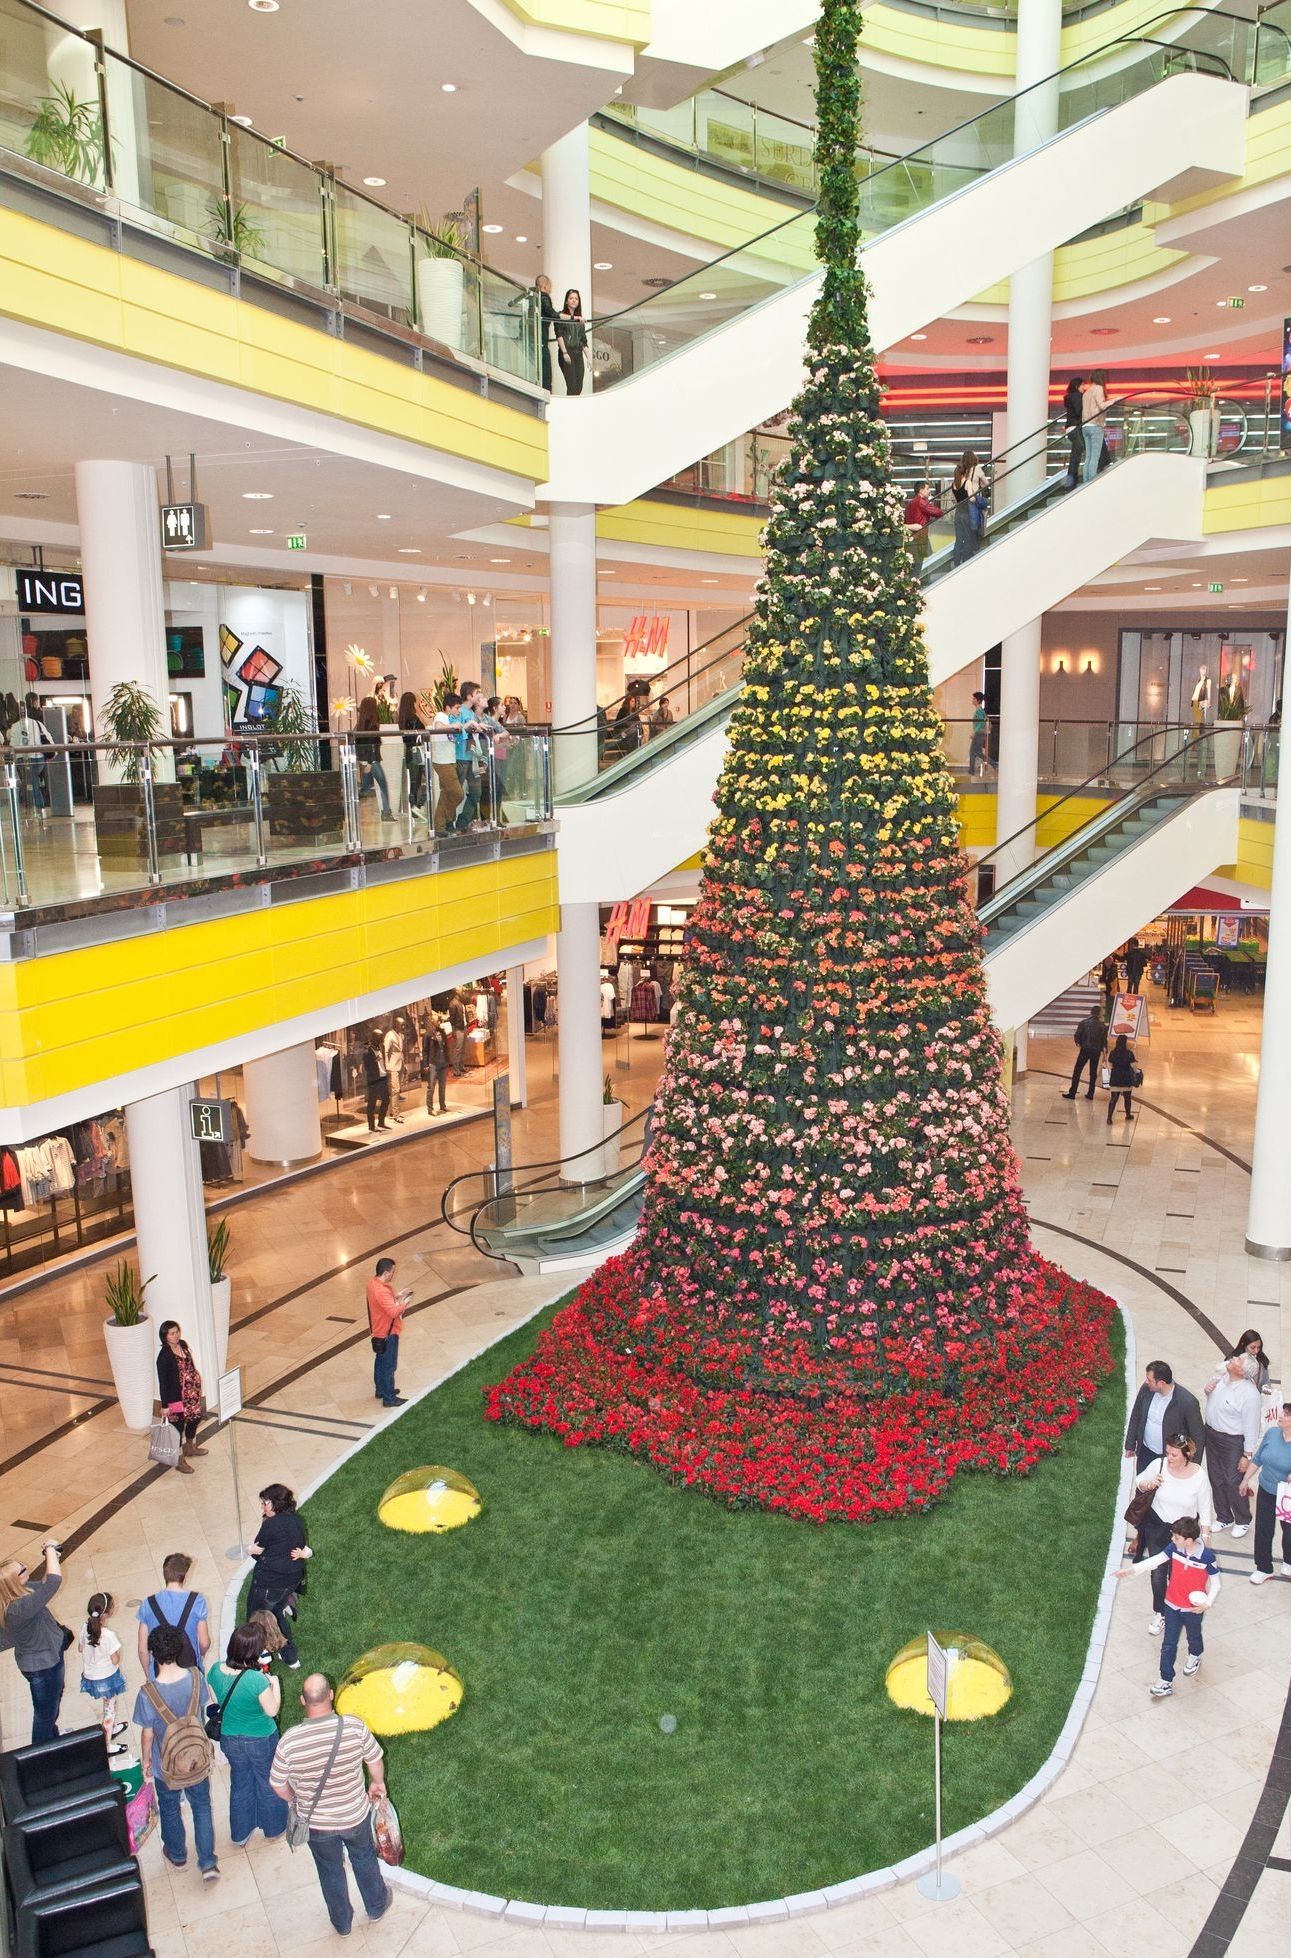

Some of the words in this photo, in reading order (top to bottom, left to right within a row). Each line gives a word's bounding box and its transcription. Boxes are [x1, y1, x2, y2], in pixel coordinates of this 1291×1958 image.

[760, 137, 813, 168] SERD
[24, 578, 82, 607] ING
[623, 616, 670, 658] H&M
[604, 896, 652, 944] H&M
